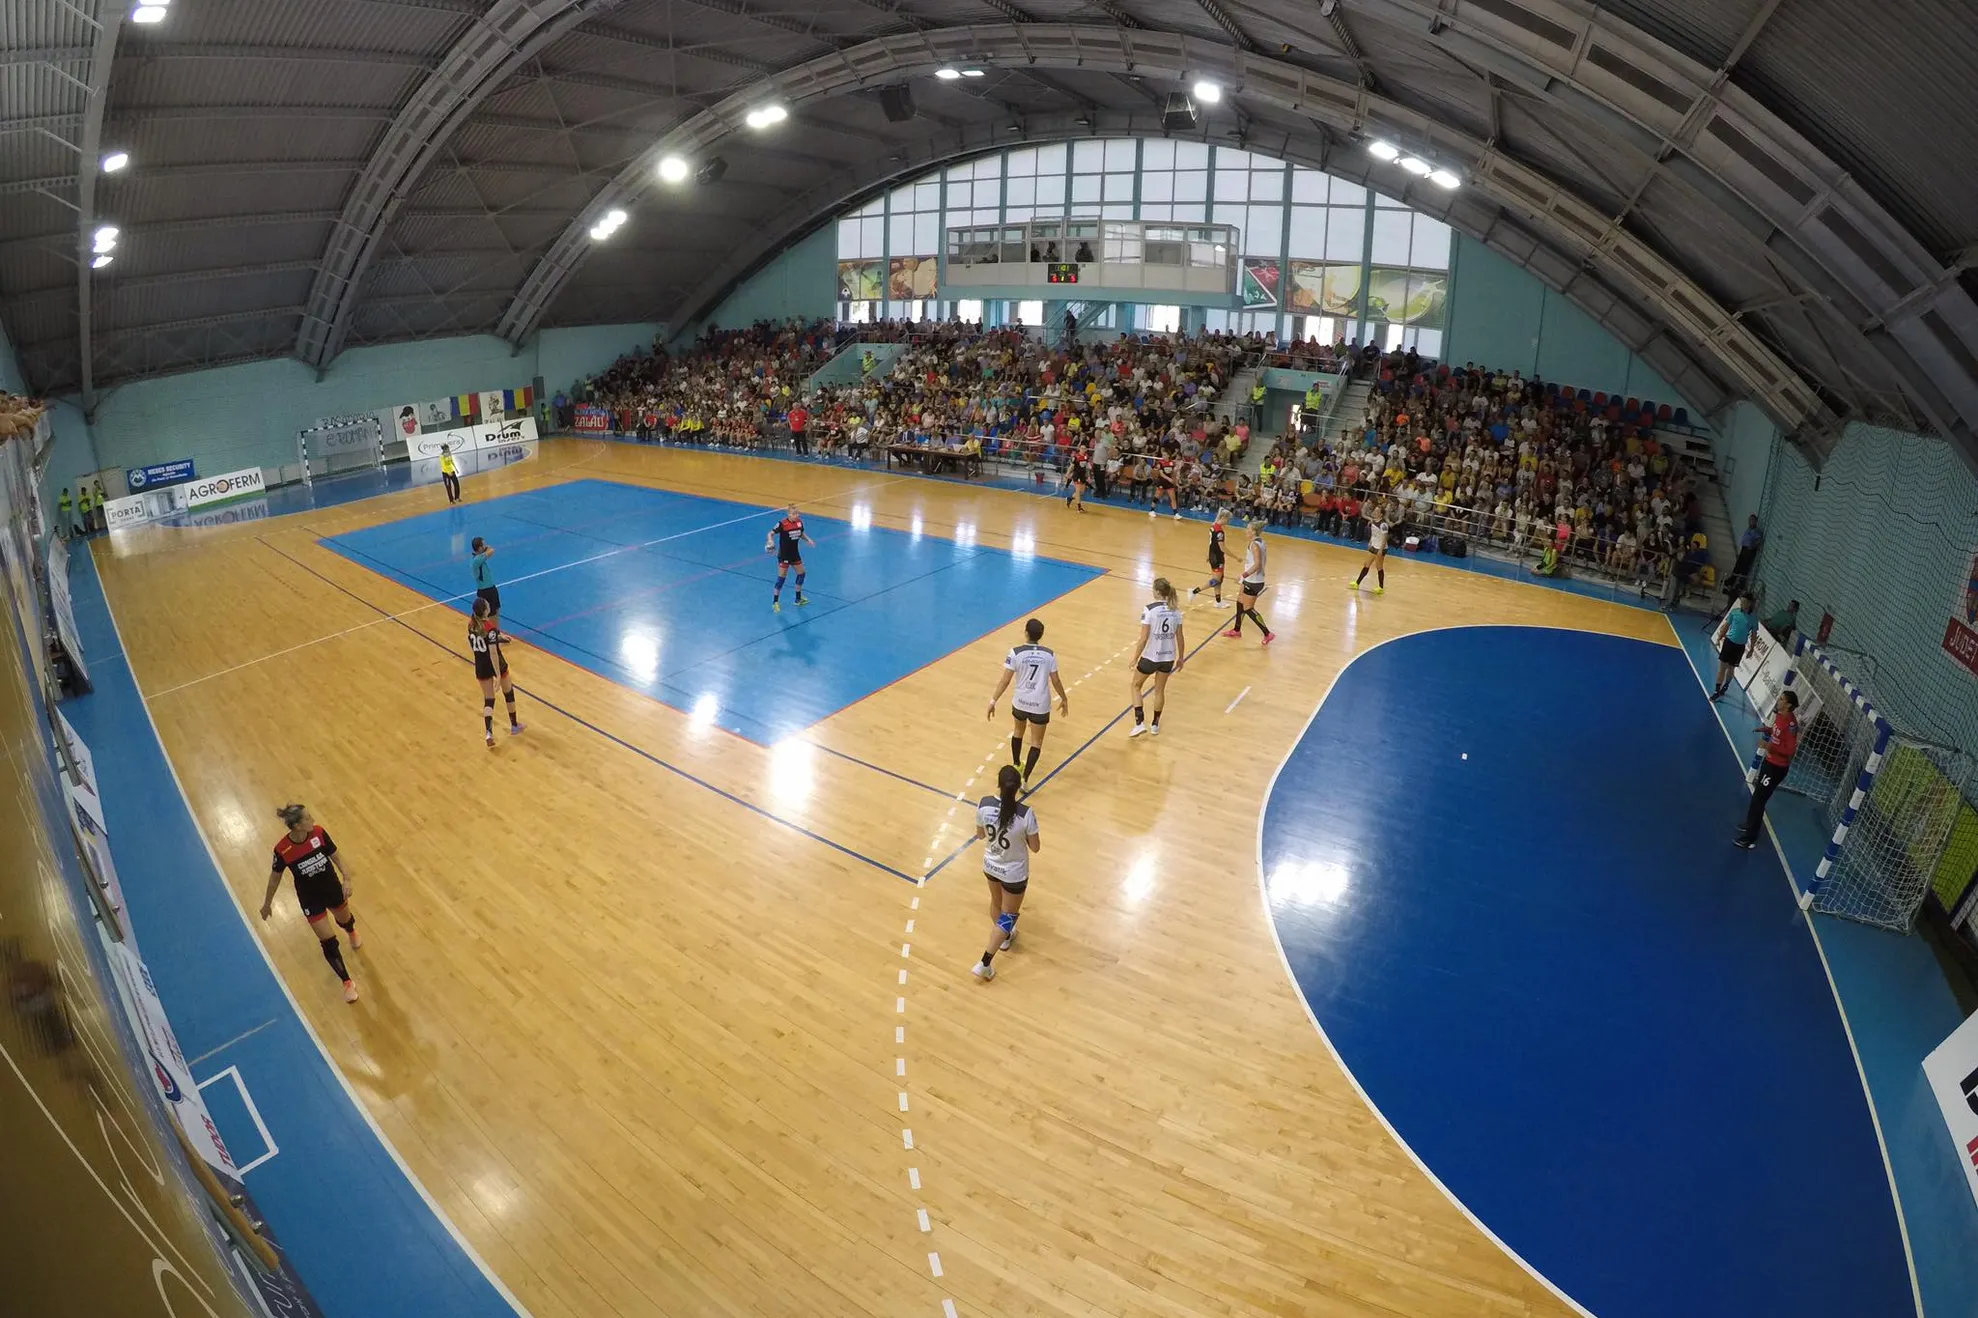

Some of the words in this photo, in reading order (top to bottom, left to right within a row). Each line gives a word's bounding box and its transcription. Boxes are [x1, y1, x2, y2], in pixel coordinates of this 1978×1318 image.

[485, 431, 521, 442] Drum
[189, 472, 261, 500] AGROFERM
[110, 506, 142, 519] PORTA
[1161, 617, 1170, 633] 6
[1029, 664, 1039, 681] 7
[1760, 774, 1771, 787] 16
[985, 823, 1011, 850] 96
